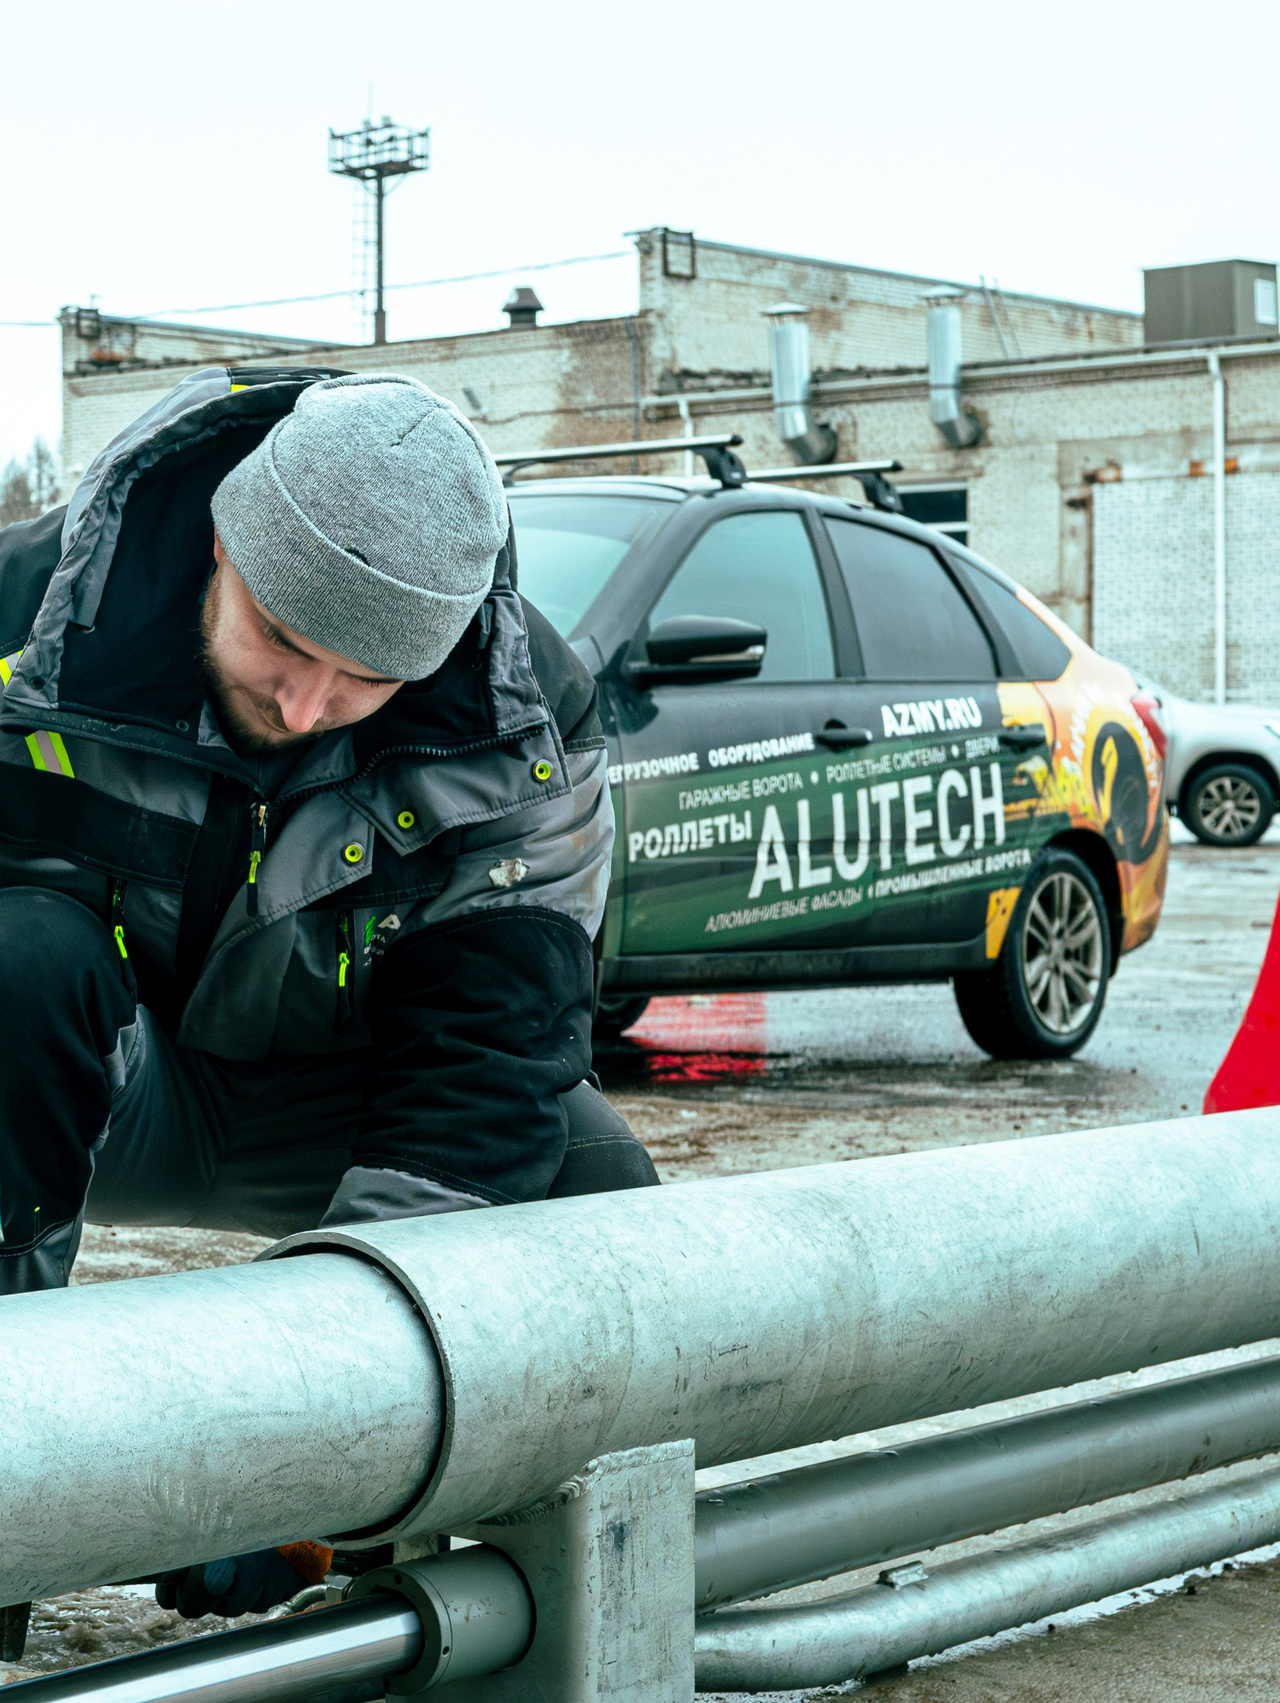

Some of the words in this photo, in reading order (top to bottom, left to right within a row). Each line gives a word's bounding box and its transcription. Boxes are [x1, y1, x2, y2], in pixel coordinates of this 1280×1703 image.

[880, 696, 983, 738] AZMY.RU
[606, 751, 700, 785] ЕГРУЗОЧНОЕ
[707, 732, 816, 768] ОБОРУДОВАНИЕ
[678, 780, 752, 811] ГАРАЖНЫЕ
[752, 772, 804, 798] ВОРОТА
[892, 745, 947, 771] СИСТЕМЫ
[628, 810, 752, 862] РОЛЛЕТЫ
[748, 762, 1006, 899] ALUTECH
[705, 896, 810, 932] АЛЮМИНИЕВЫЕ
[811, 885, 863, 911] ФАСАДЫ
[875, 858, 984, 898] ПРОМЫШЛЕННЫЕ
[984, 848, 1032, 874] ВОРОТА
